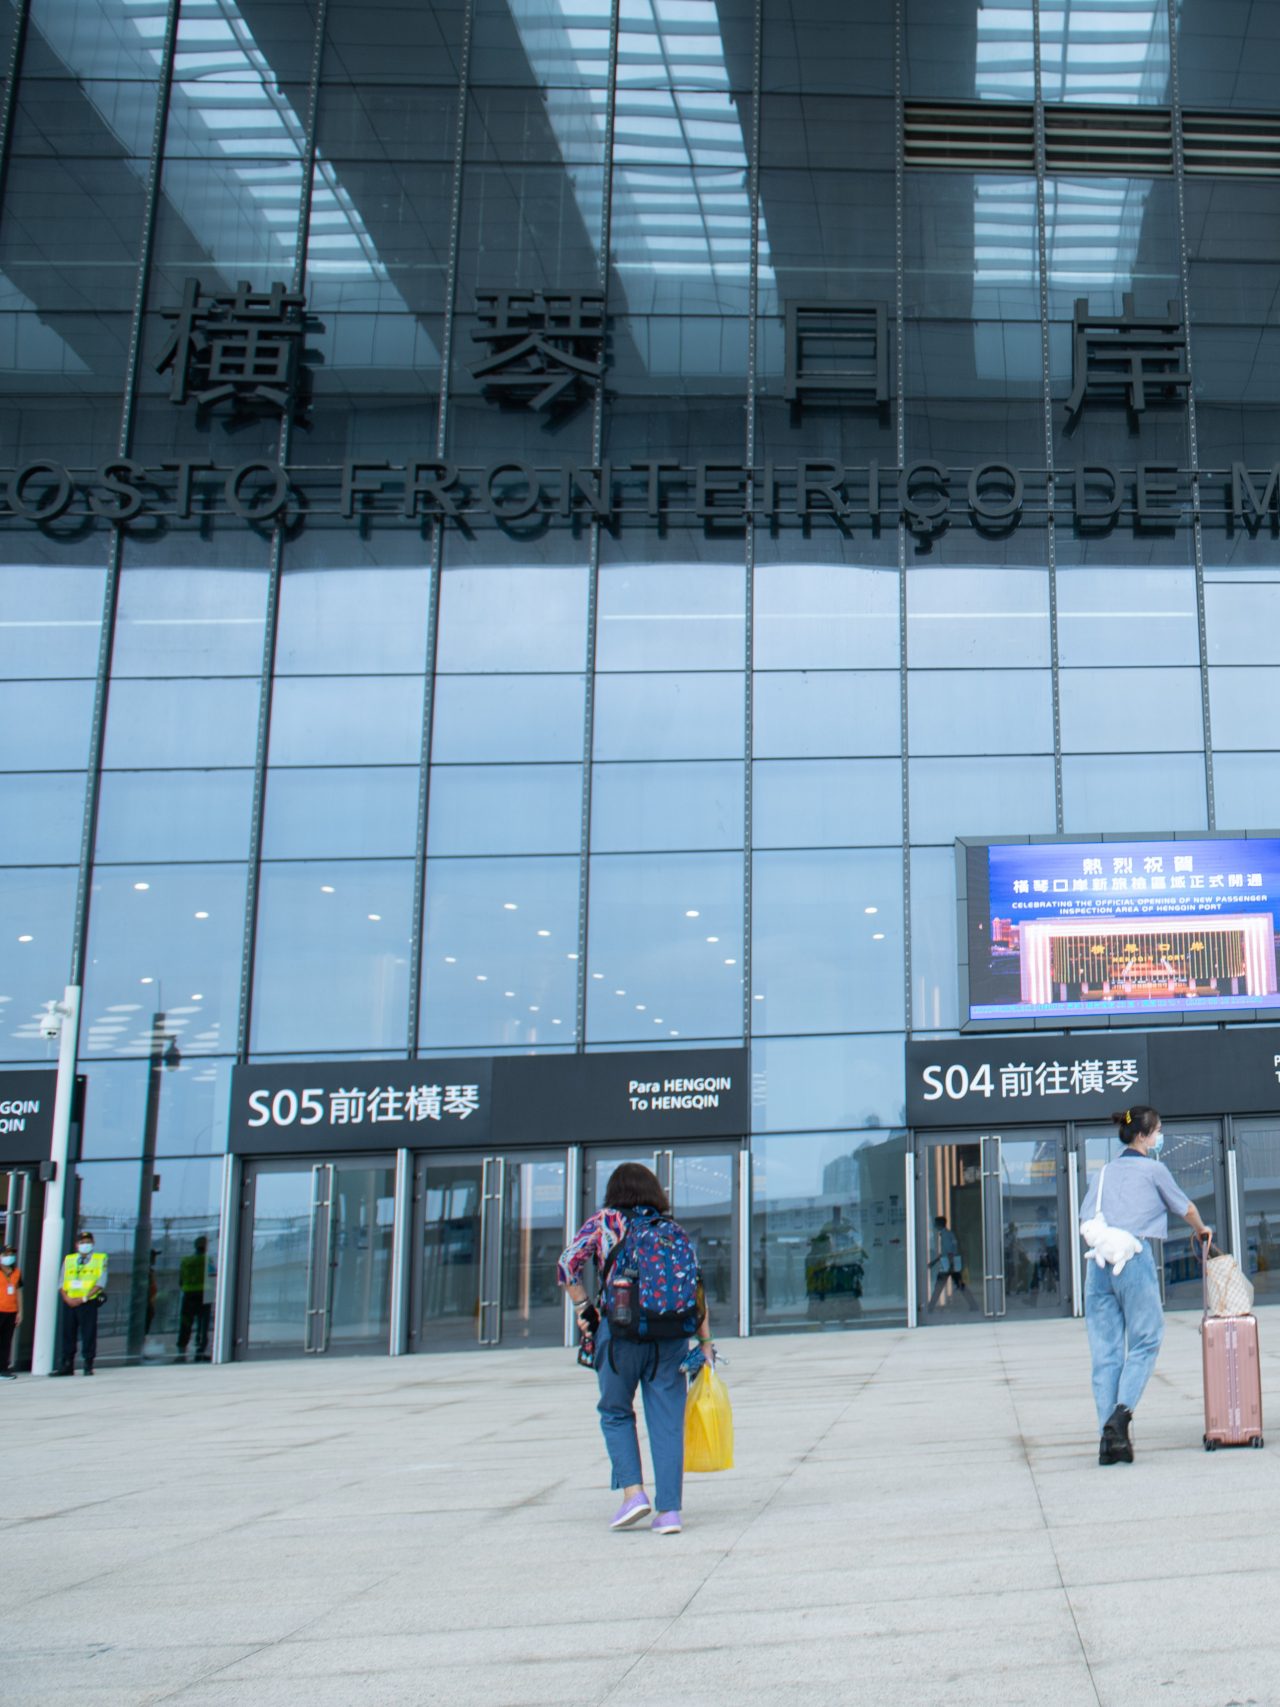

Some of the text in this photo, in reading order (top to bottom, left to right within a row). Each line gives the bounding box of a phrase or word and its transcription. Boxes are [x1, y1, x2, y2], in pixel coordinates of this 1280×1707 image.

[341, 457, 1025, 532] FRONTEIRIÇO
[1073, 459, 1182, 518] DE
[1011, 901, 1073, 909] CELEBRATING
[1215, 895, 1268, 903] PASSENGER
[1060, 907, 1113, 915] INSPECTION
[1115, 905, 1139, 913] AREA
[1199, 903, 1222, 911] PORT
[628, 1077, 732, 1094] Para HENGQIN
[922, 1058, 1139, 1101] S04 前往橫琴
[247, 1084, 480, 1127] S05 前往橫琴
[629, 1094, 720, 1111] To HENGQIN
